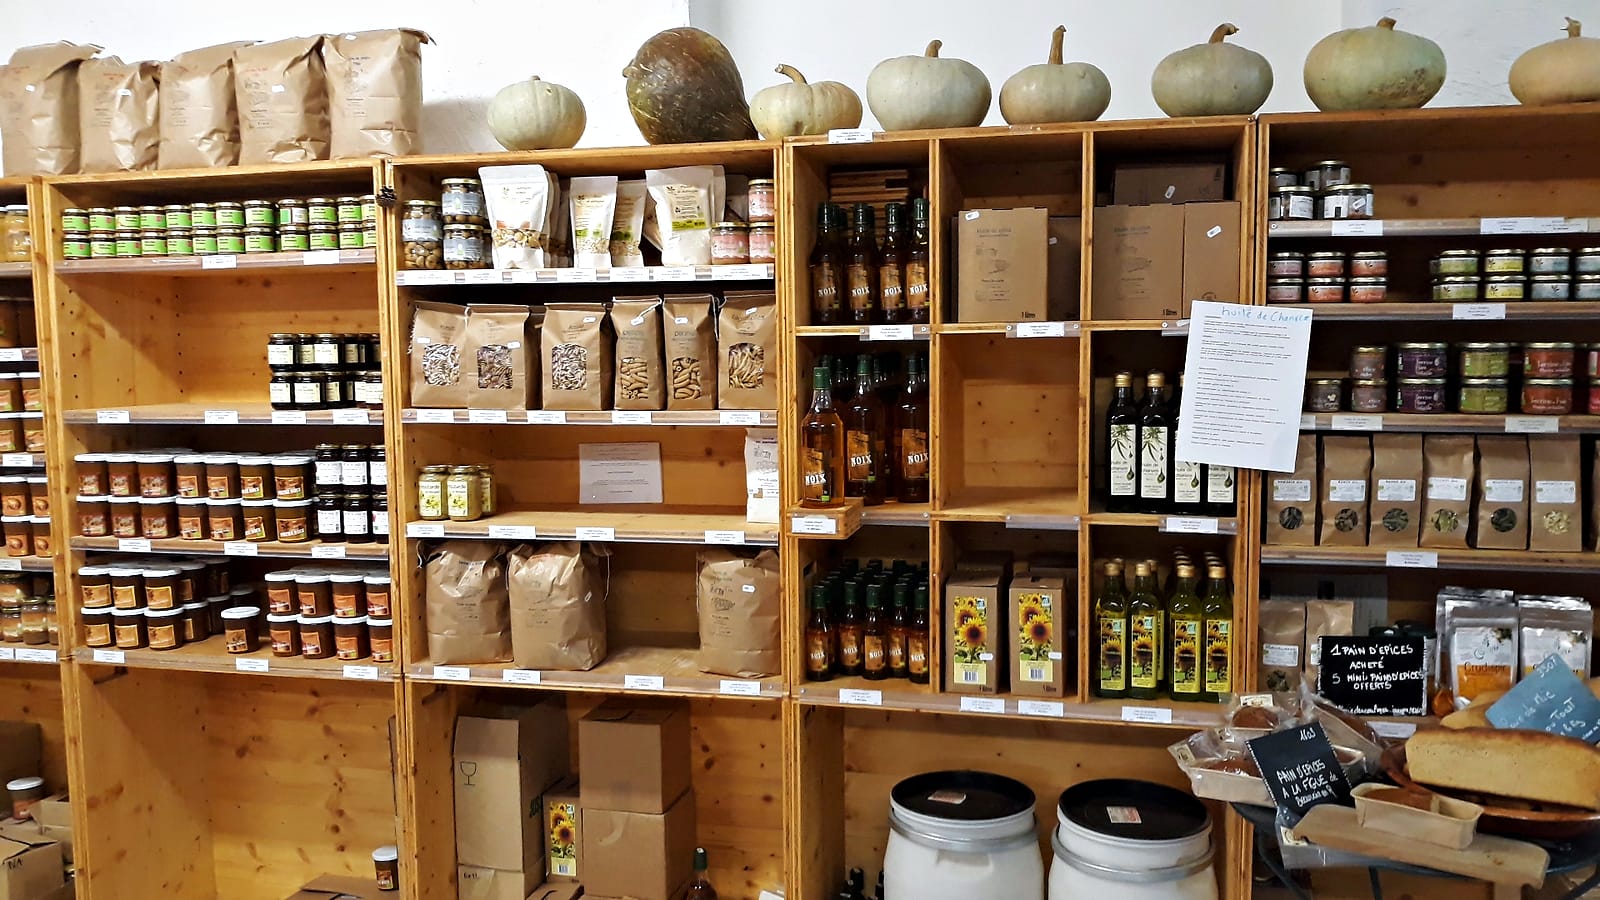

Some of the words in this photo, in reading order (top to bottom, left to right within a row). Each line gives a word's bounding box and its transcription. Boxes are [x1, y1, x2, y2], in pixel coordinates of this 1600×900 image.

[818, 286, 837, 297] NOIX
[852, 286, 870, 297] NOIX
[884, 286, 902, 297] NOIX
[910, 283, 928, 295] NOIX
[851, 454, 872, 468] NOIX
[908, 452, 929, 465] NOIX
[805, 473, 827, 486] NOIX
[1330, 644, 1341, 656] 1
[1349, 655, 1385, 670] ACHETÉ
[1332, 673, 1341, 685] 5
[1353, 681, 1392, 691] OFFERTS
